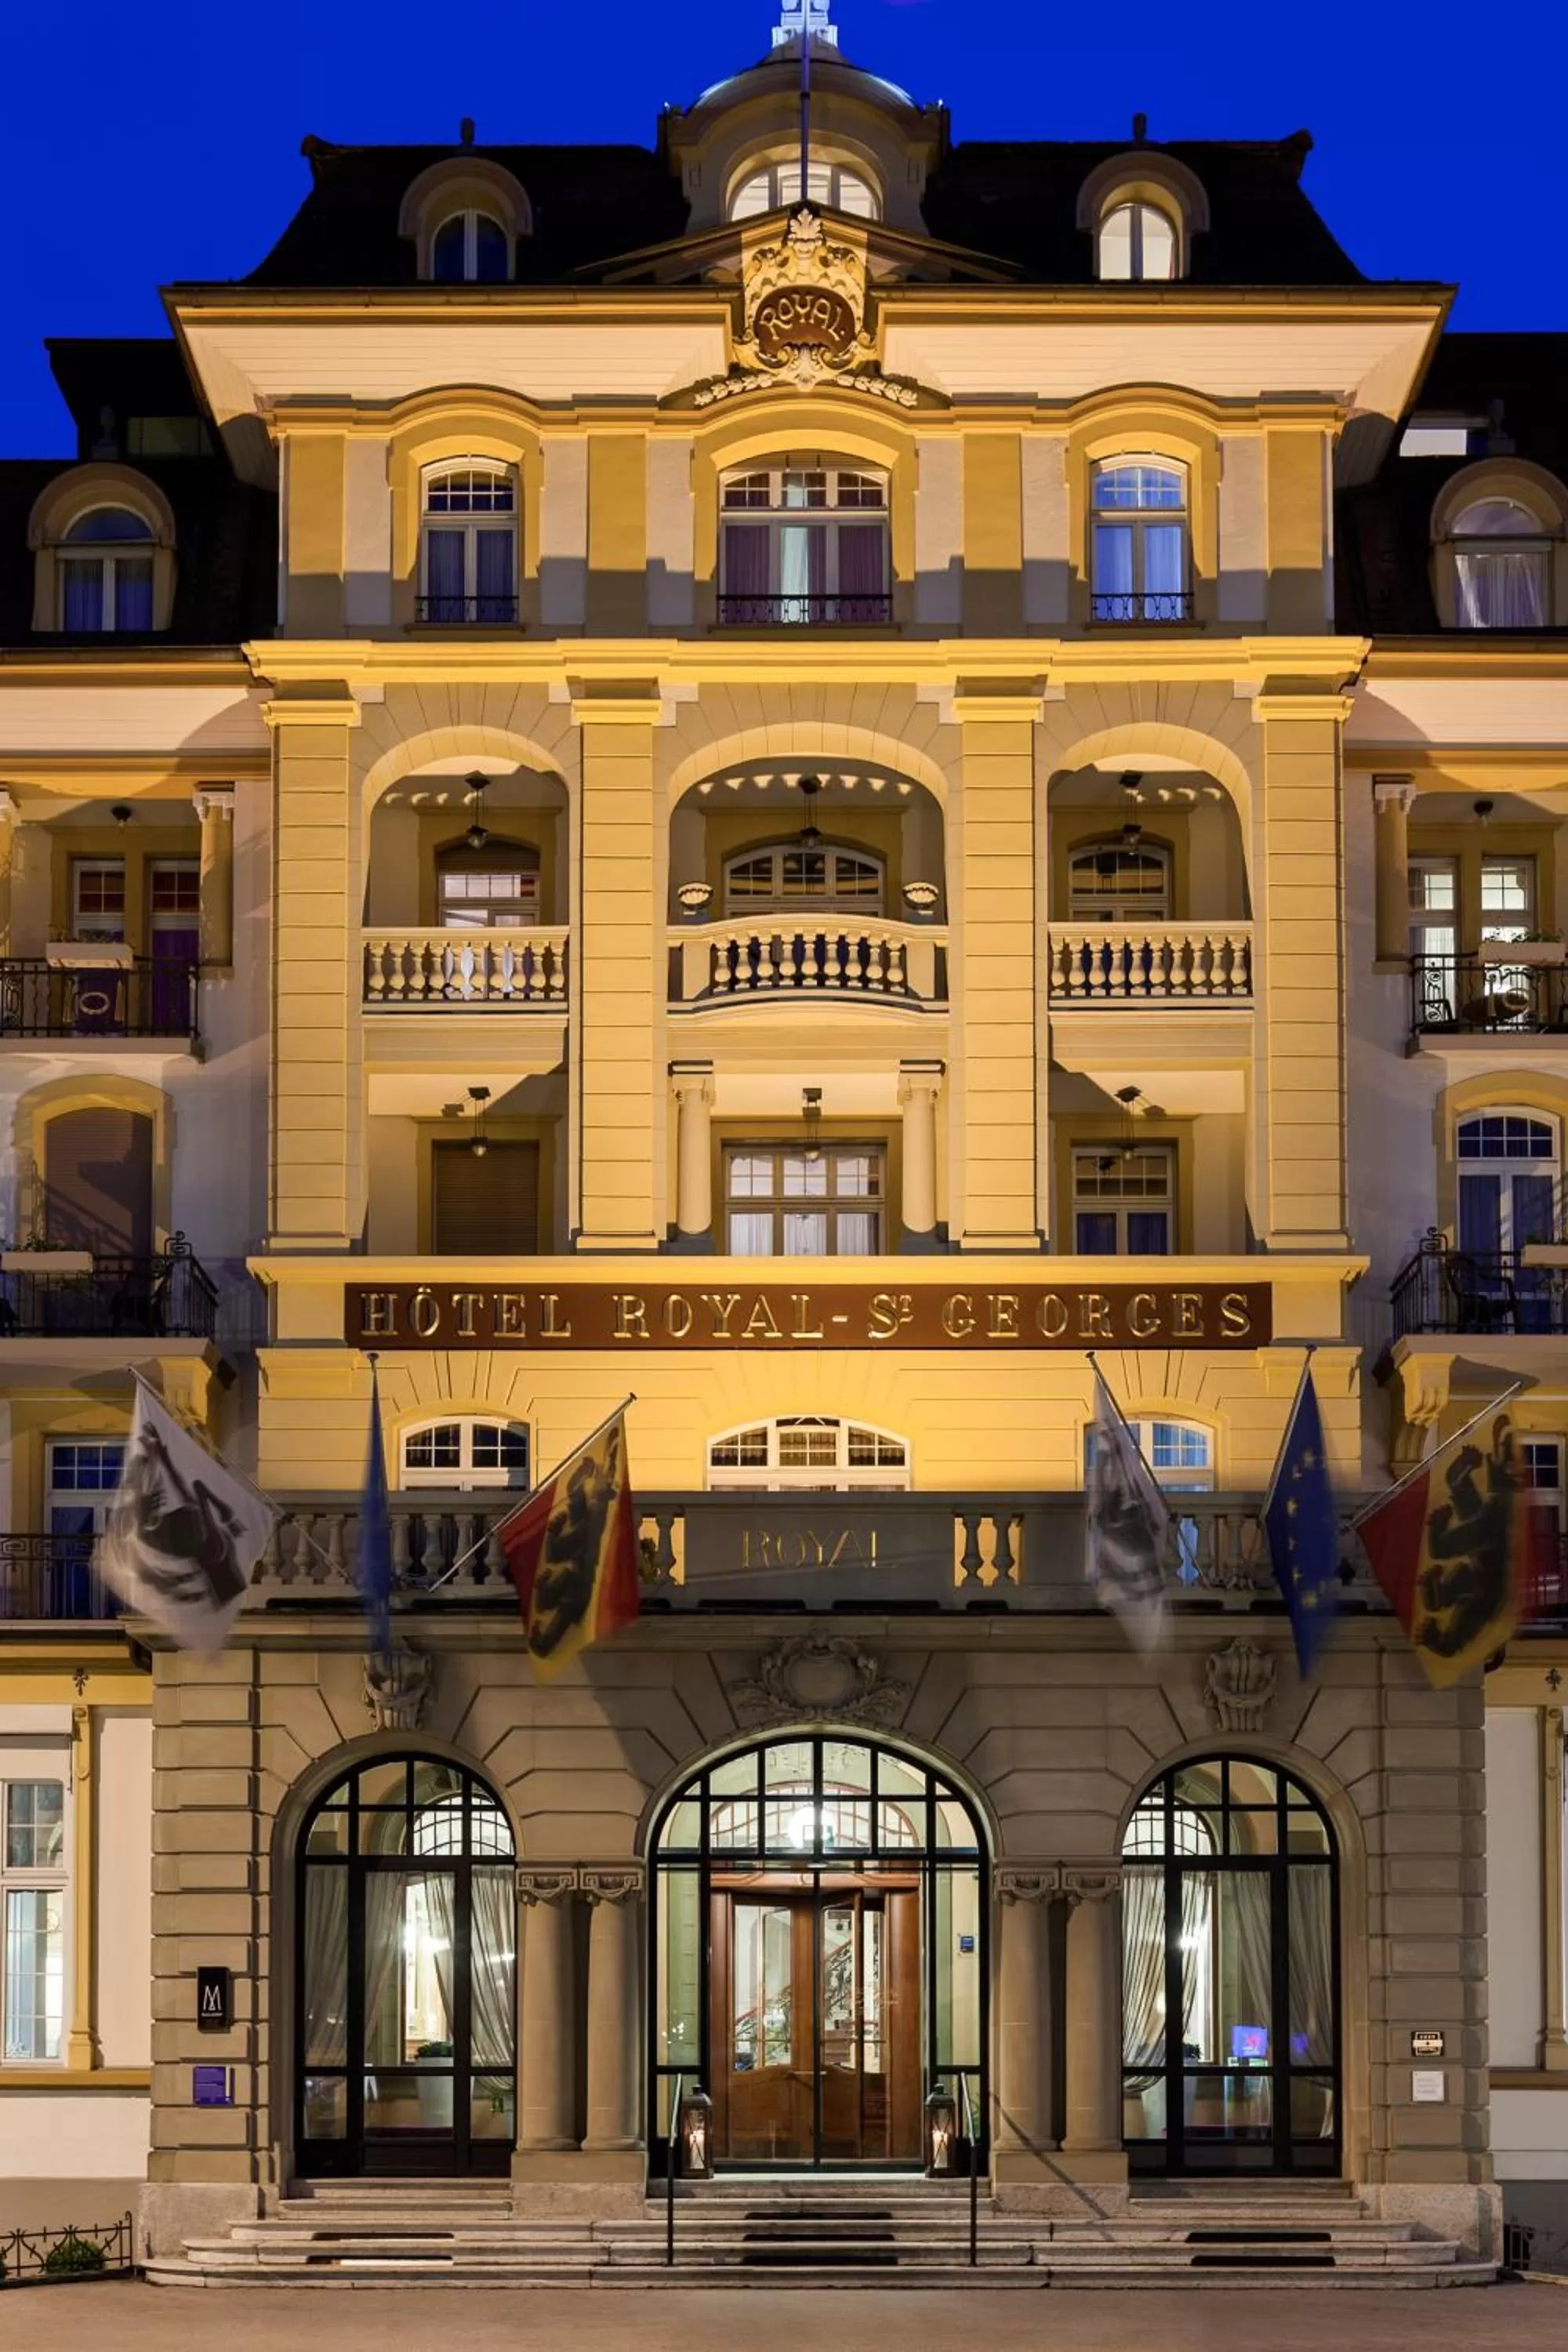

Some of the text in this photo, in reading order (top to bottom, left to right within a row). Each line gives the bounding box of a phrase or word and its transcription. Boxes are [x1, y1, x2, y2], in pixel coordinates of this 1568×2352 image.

[759, 293, 845, 341] ROYAL
[942, 1292, 1252, 1338] GEORGES
[742, 1530, 898, 1569] ROYAL
